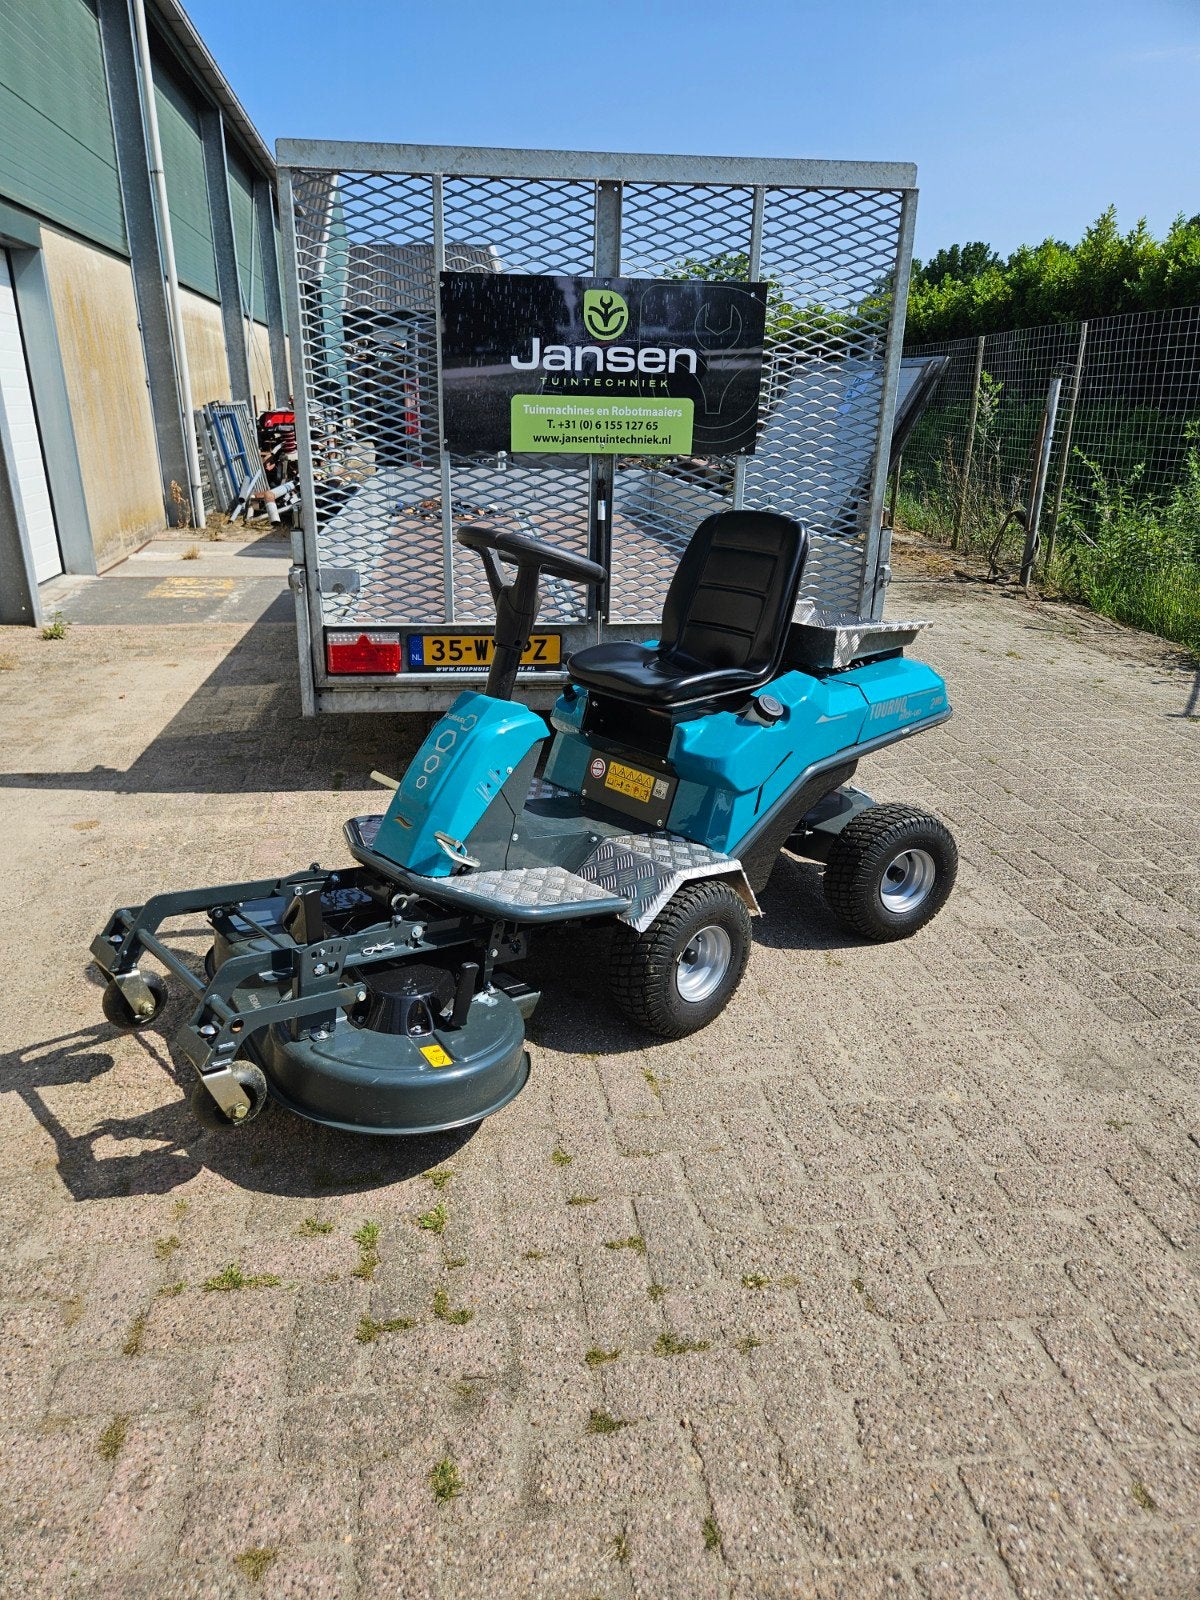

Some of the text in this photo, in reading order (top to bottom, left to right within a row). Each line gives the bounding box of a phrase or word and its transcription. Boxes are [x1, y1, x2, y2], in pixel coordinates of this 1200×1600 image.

[510, 337, 698, 374] Jansen
[540, 377, 669, 388] TUINTECHNIEK
[523, 404, 683, 417] Tuinmachines en Robotmaaiers
[547, 419, 659, 431] T. +31 (0) 6 155 127 65
[533, 433, 672, 445] www.jansentuintechniek.nl
[431, 639, 548, 661] 35-WPZ
[411, 653, 423, 661] NL
